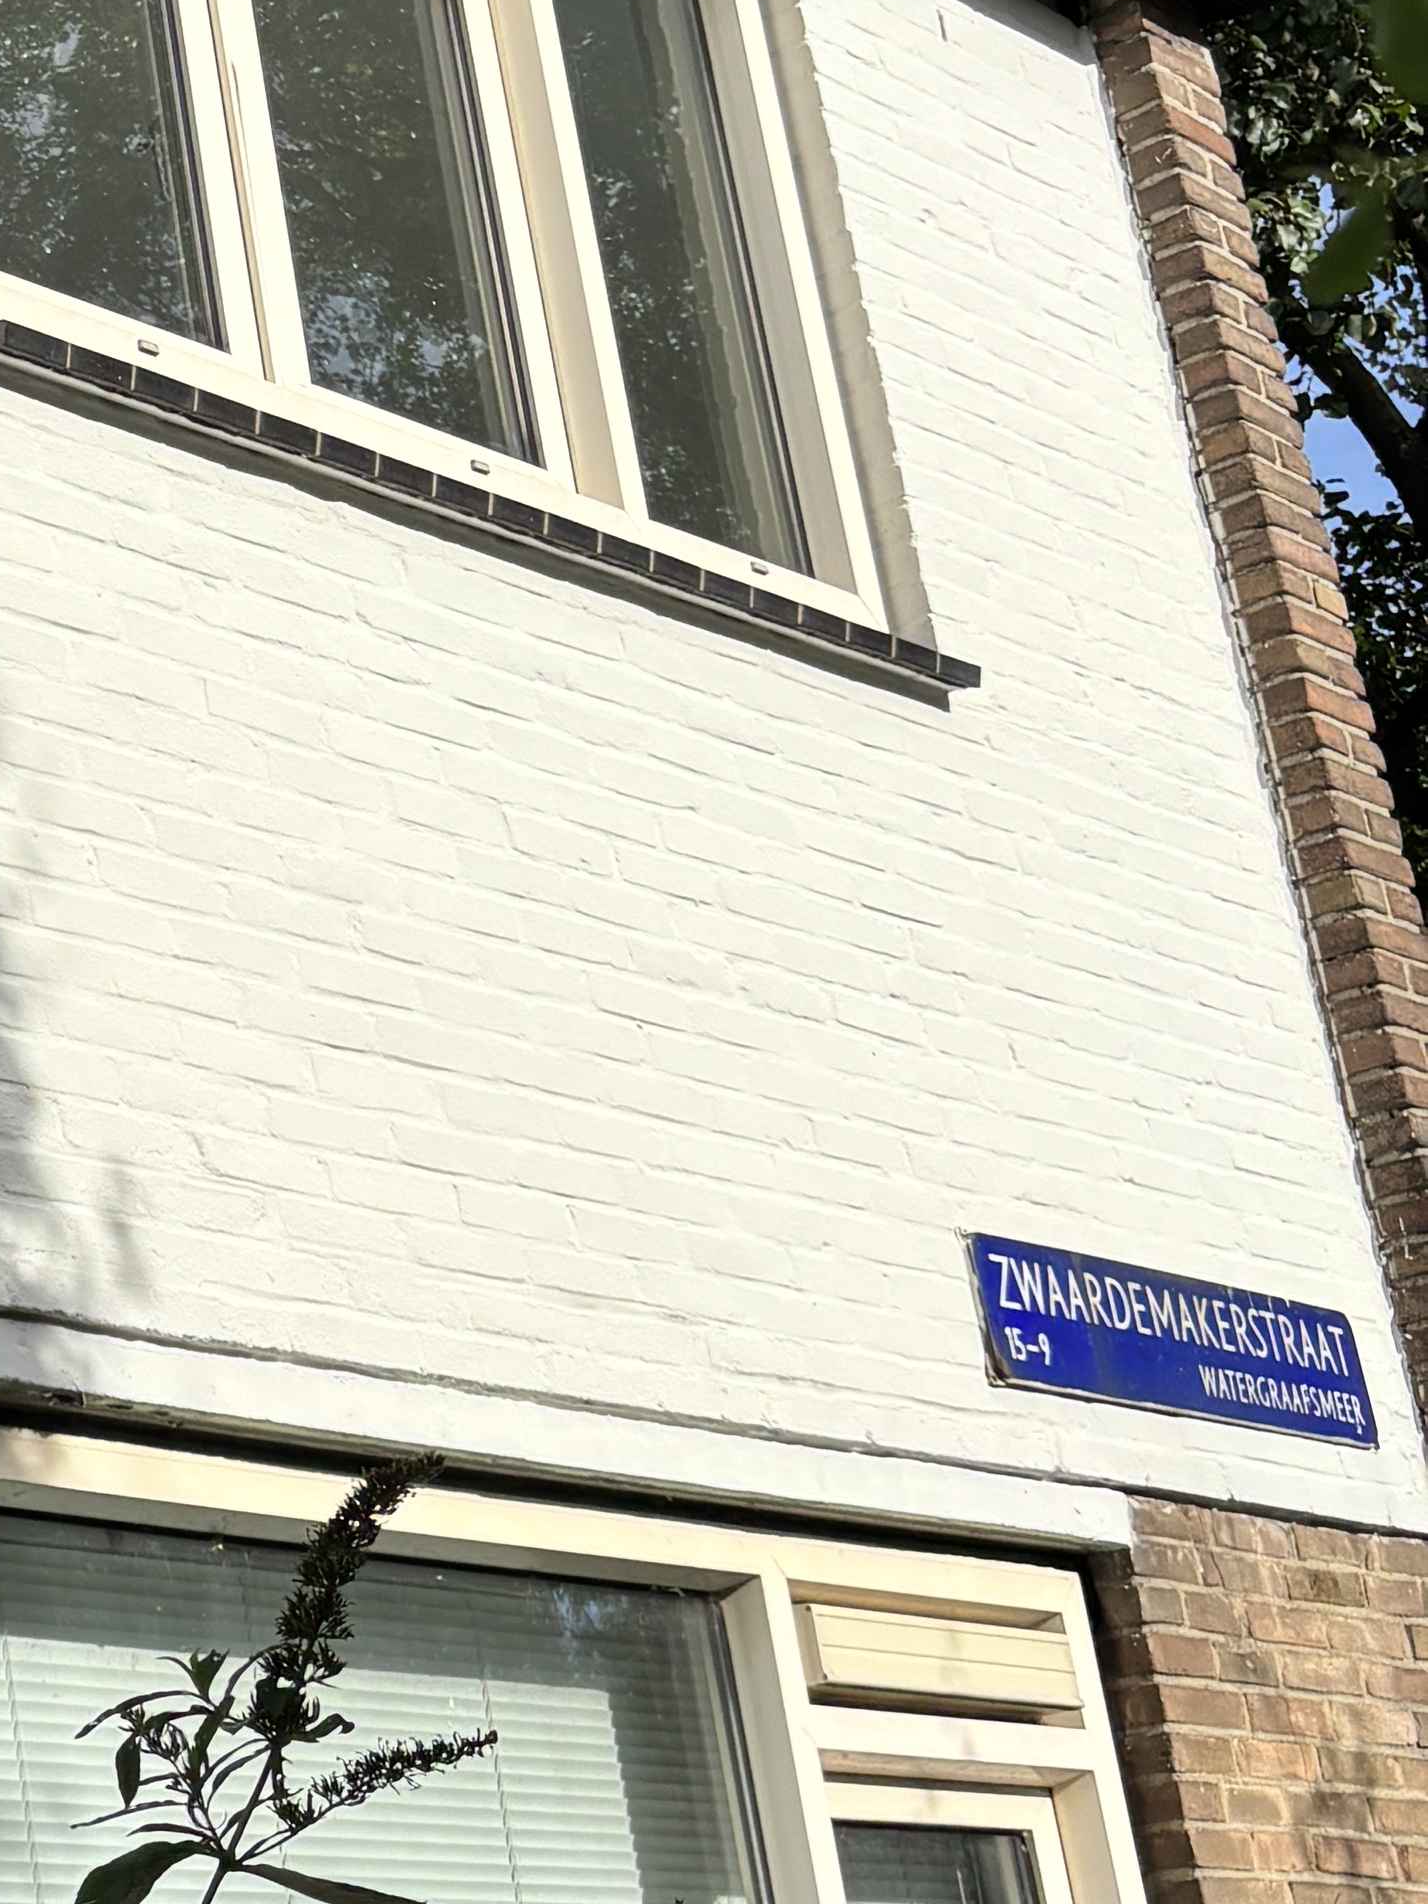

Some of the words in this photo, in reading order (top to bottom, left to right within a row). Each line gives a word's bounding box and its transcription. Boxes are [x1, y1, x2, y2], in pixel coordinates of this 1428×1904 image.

[988, 1253, 1349, 1377] ZWAARDEMAKERSTRAAT
[1004, 1326, 1051, 1366] 15-9
[1198, 1364, 1366, 1426] WATERGRAAFSMEER
